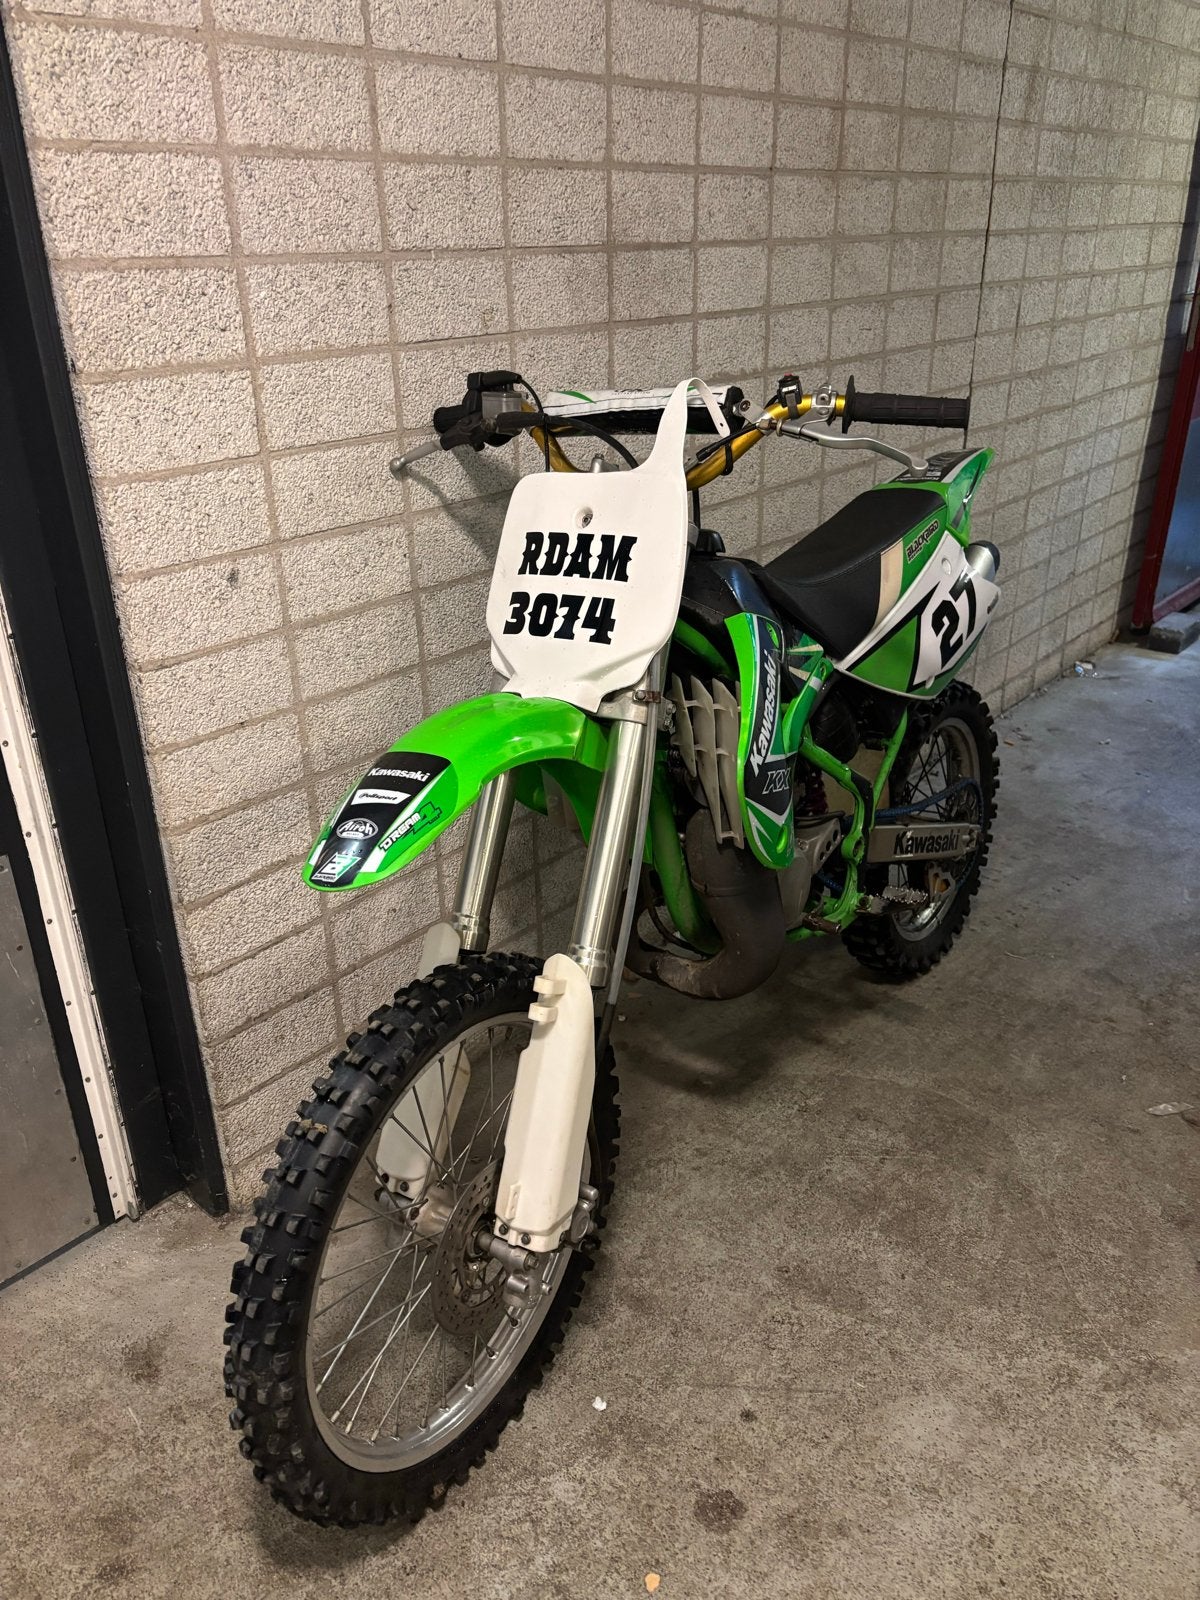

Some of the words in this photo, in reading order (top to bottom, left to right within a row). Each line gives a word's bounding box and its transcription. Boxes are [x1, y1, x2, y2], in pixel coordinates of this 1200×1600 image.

[517, 531, 638, 582] RDAM
[503, 591, 616, 645] 3074
[931, 567, 977, 670] 27
[750, 649, 778, 777] Kawasaki
[367, 767, 430, 782] Kawasaki
[762, 767, 791, 795] KX
[339, 821, 373, 835] Airoh
[893, 828, 961, 856] Kawasaki
